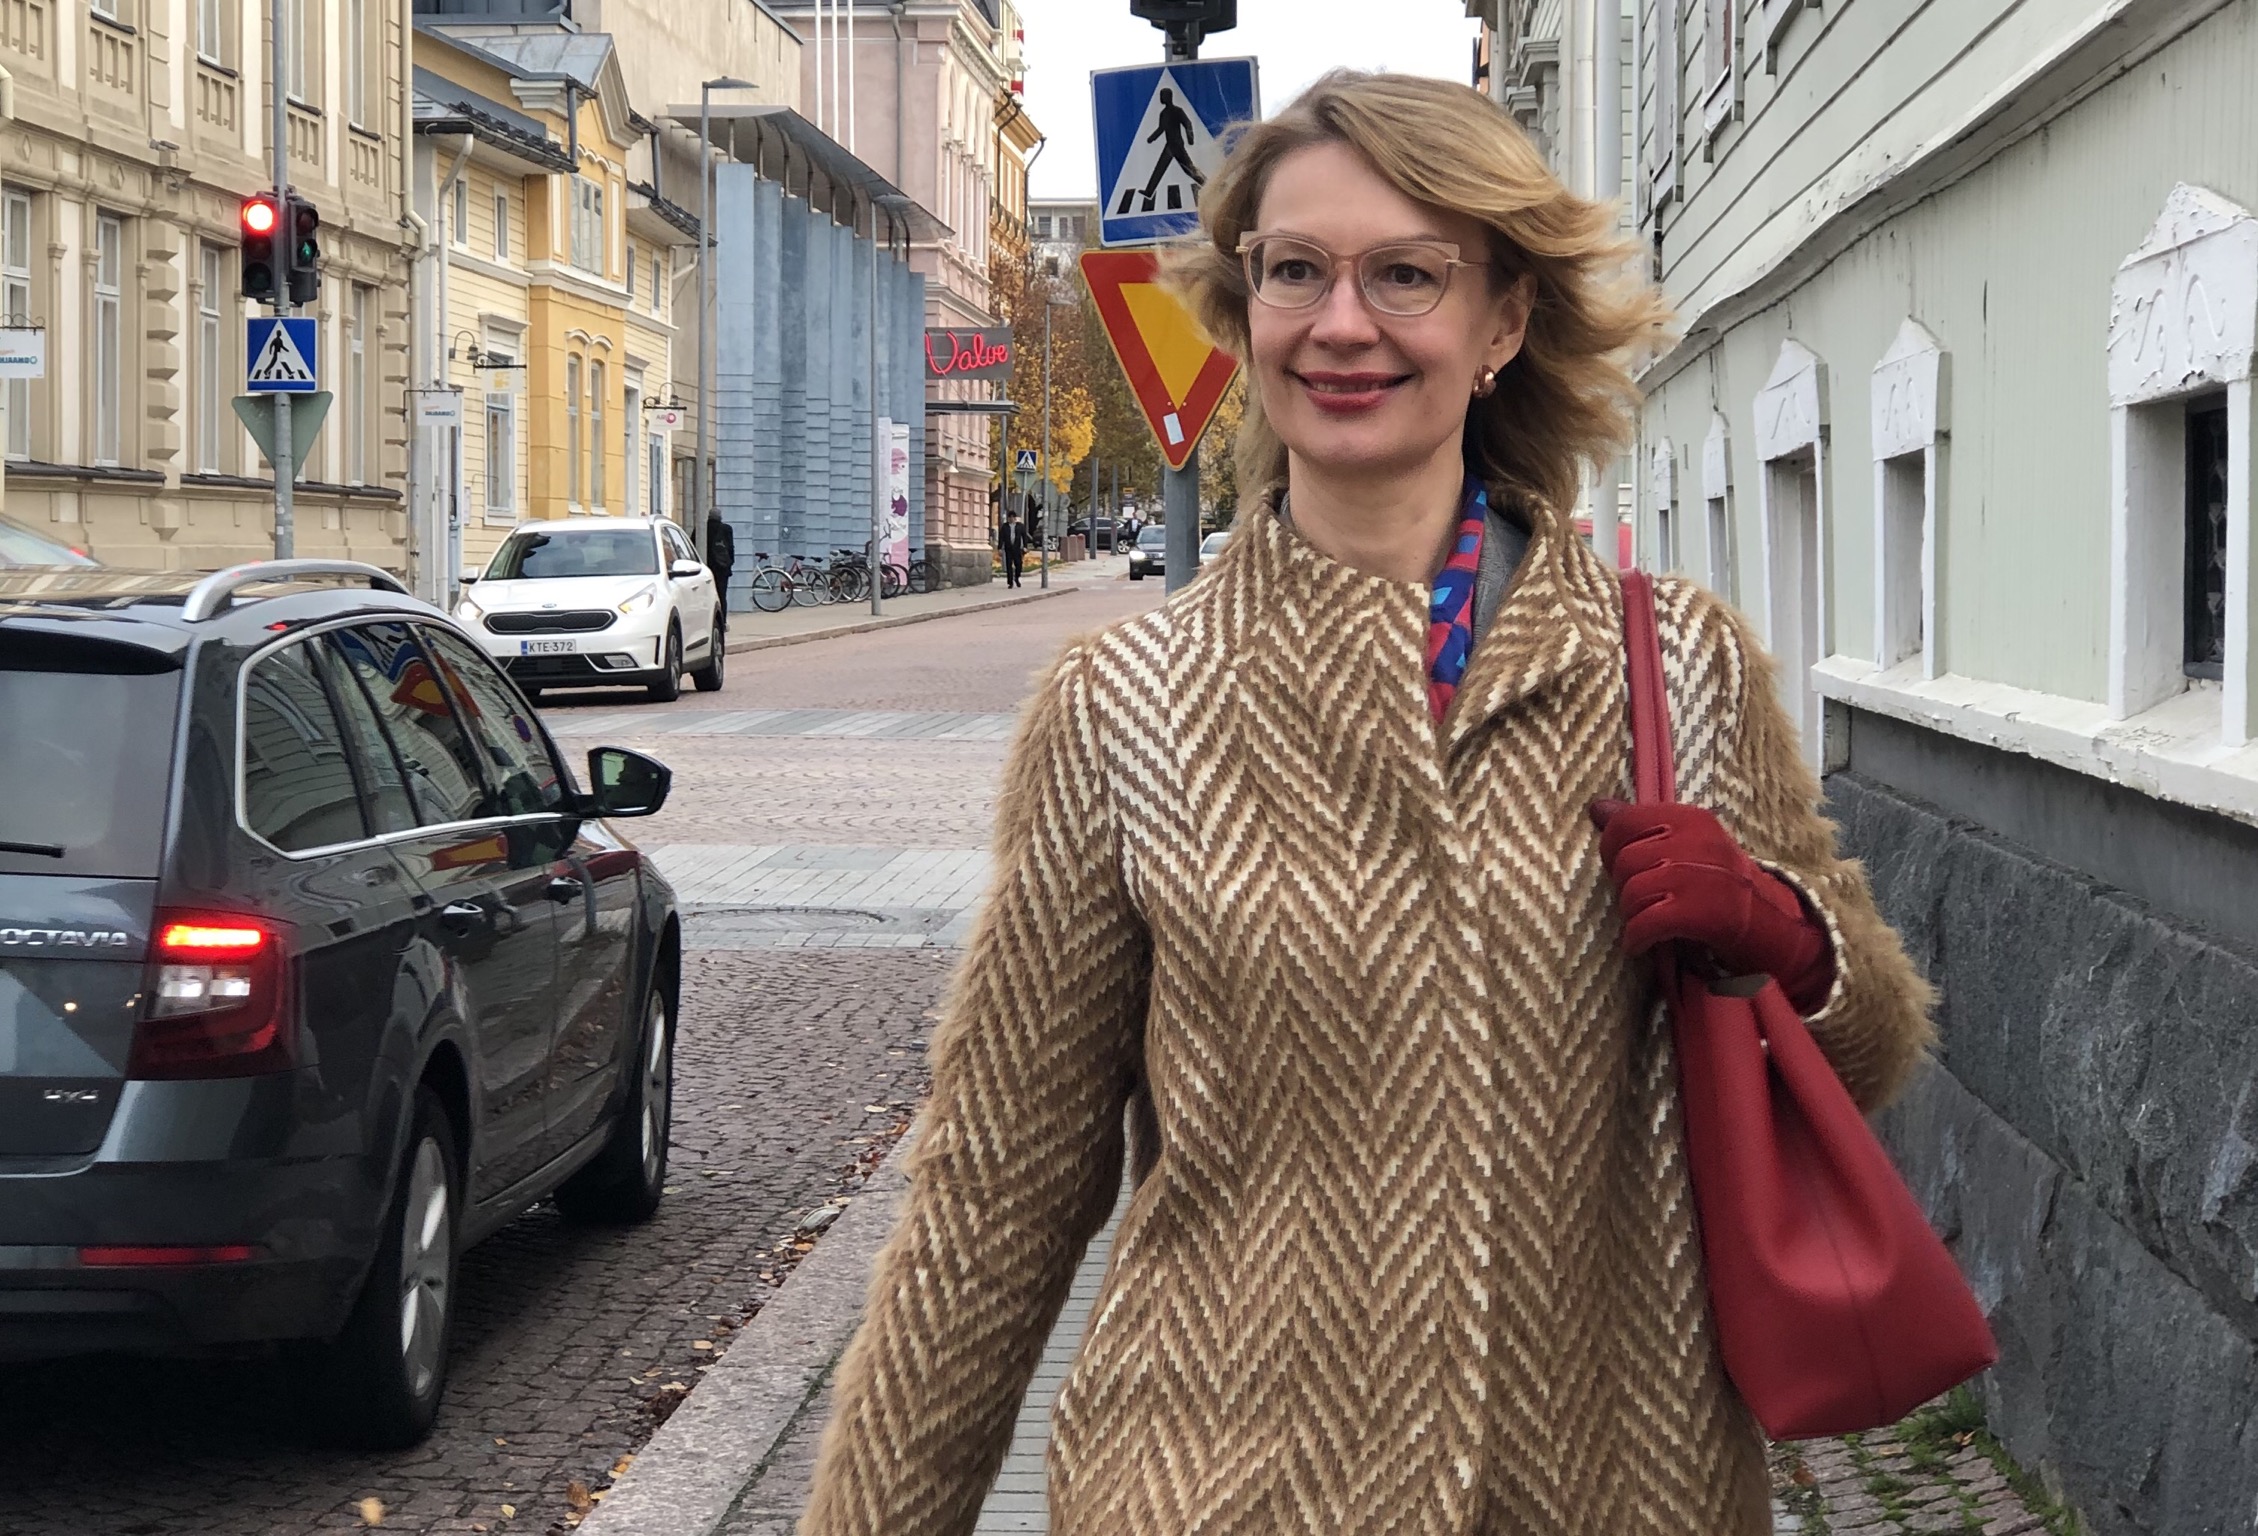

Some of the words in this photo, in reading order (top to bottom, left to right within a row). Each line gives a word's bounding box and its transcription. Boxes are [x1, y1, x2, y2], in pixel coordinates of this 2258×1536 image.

[925, 331, 1008, 375] Valve
[529, 641, 574, 653] KTE-372
[0, 928, 128, 947] OCTAVIA
